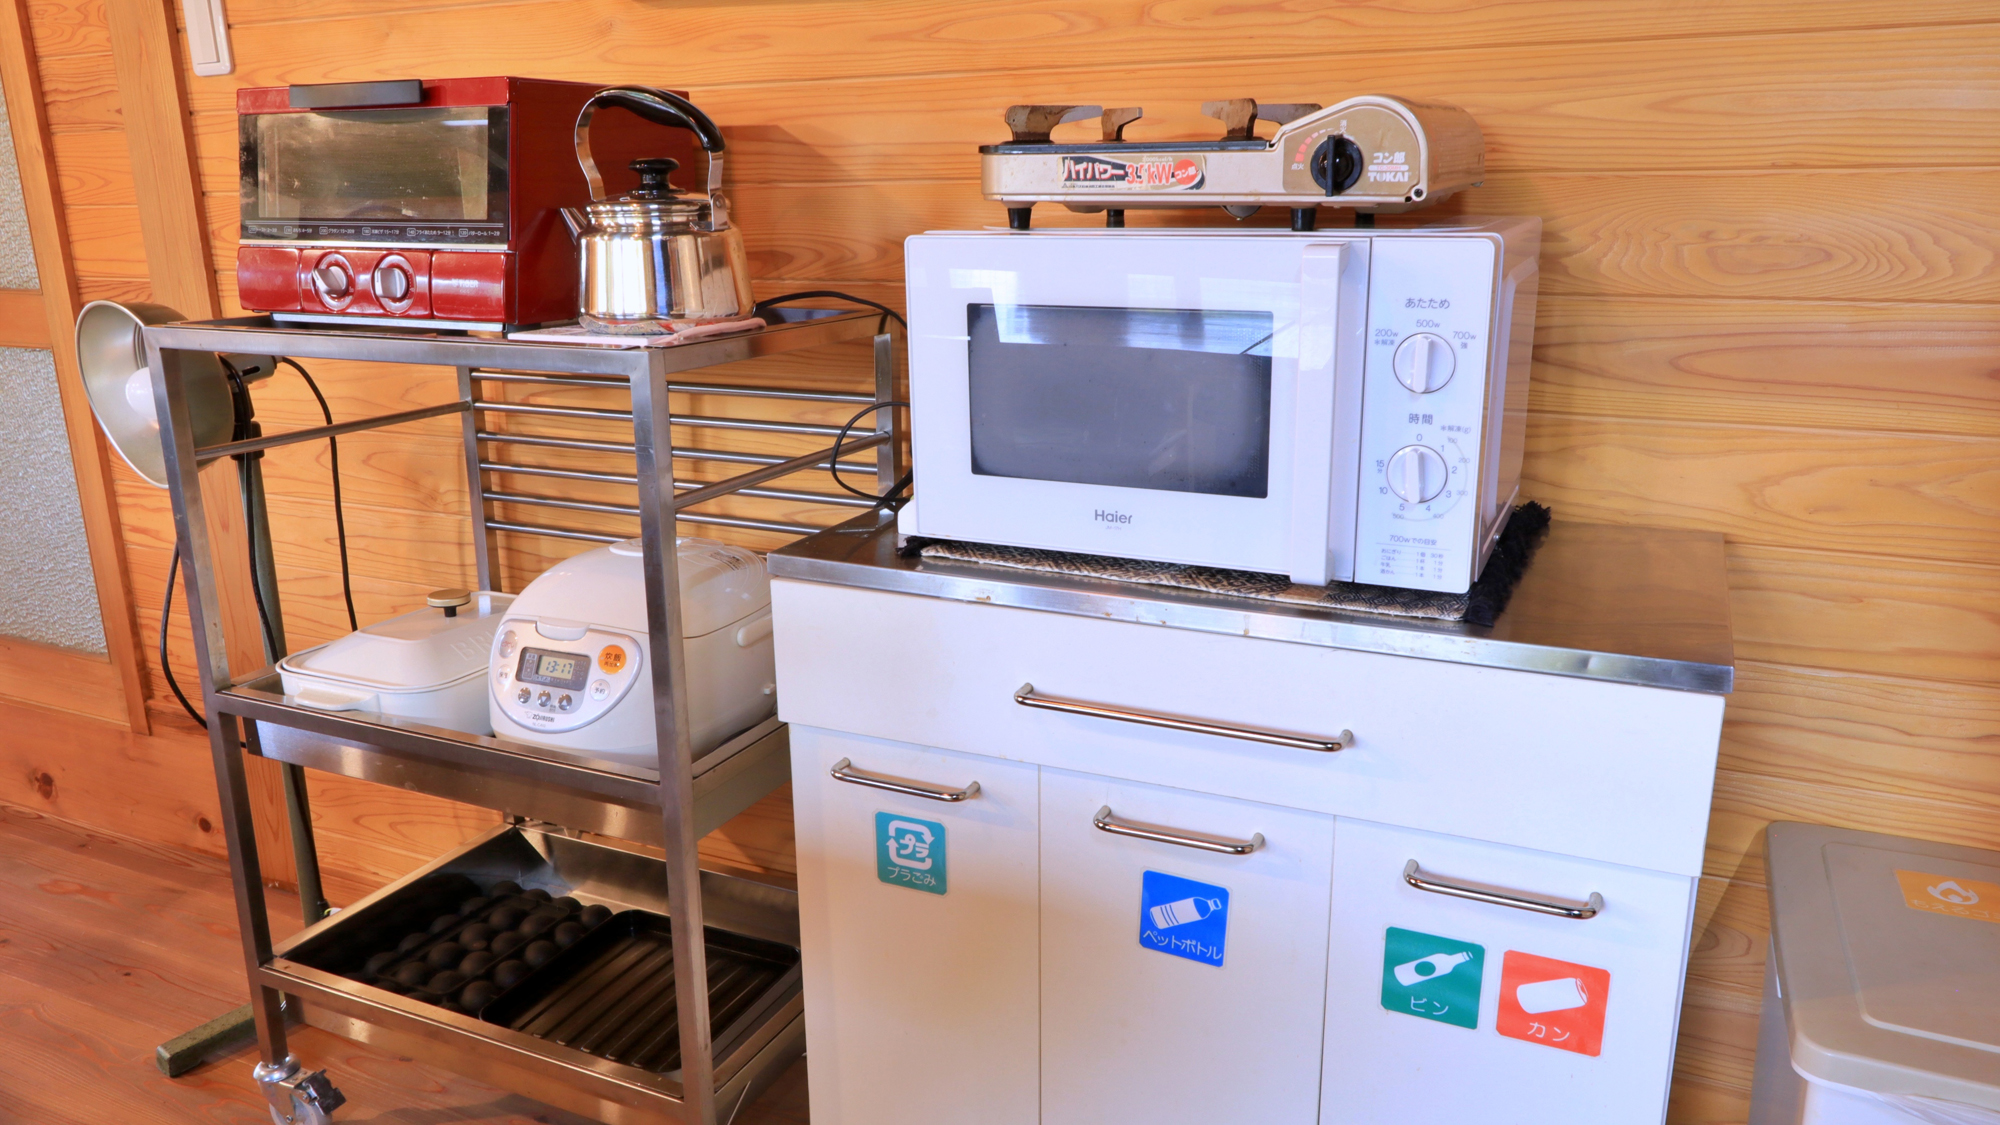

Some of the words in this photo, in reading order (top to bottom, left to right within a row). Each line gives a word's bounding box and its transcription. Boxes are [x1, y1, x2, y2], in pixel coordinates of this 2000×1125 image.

[1063, 159, 1125, 180] ハイパワー
[1367, 172, 1409, 182] TOKAI
[458, 279, 479, 288] TIGER
[1404, 297, 1450, 309] あたため
[1408, 413, 1433, 425] 時間
[1416, 433, 1423, 441] 0
[1440, 444, 1445, 452] 1
[1376, 459, 1385, 468] 15
[1451, 466, 1457, 474] 2
[1379, 486, 1388, 495] 10
[1445, 490, 1452, 498] 3
[1399, 503, 1405, 511] 5
[1425, 504, 1431, 512] 4
[1094, 509, 1133, 524] Haier
[604, 652, 622, 662] 炊飯
[545, 660, 573, 675] 13:17
[887, 866, 936, 887] プラごみ
[1143, 930, 1222, 960] ペットボトル
[1410, 995, 1449, 1015] ビン
[1527, 1021, 1570, 1042] カン
